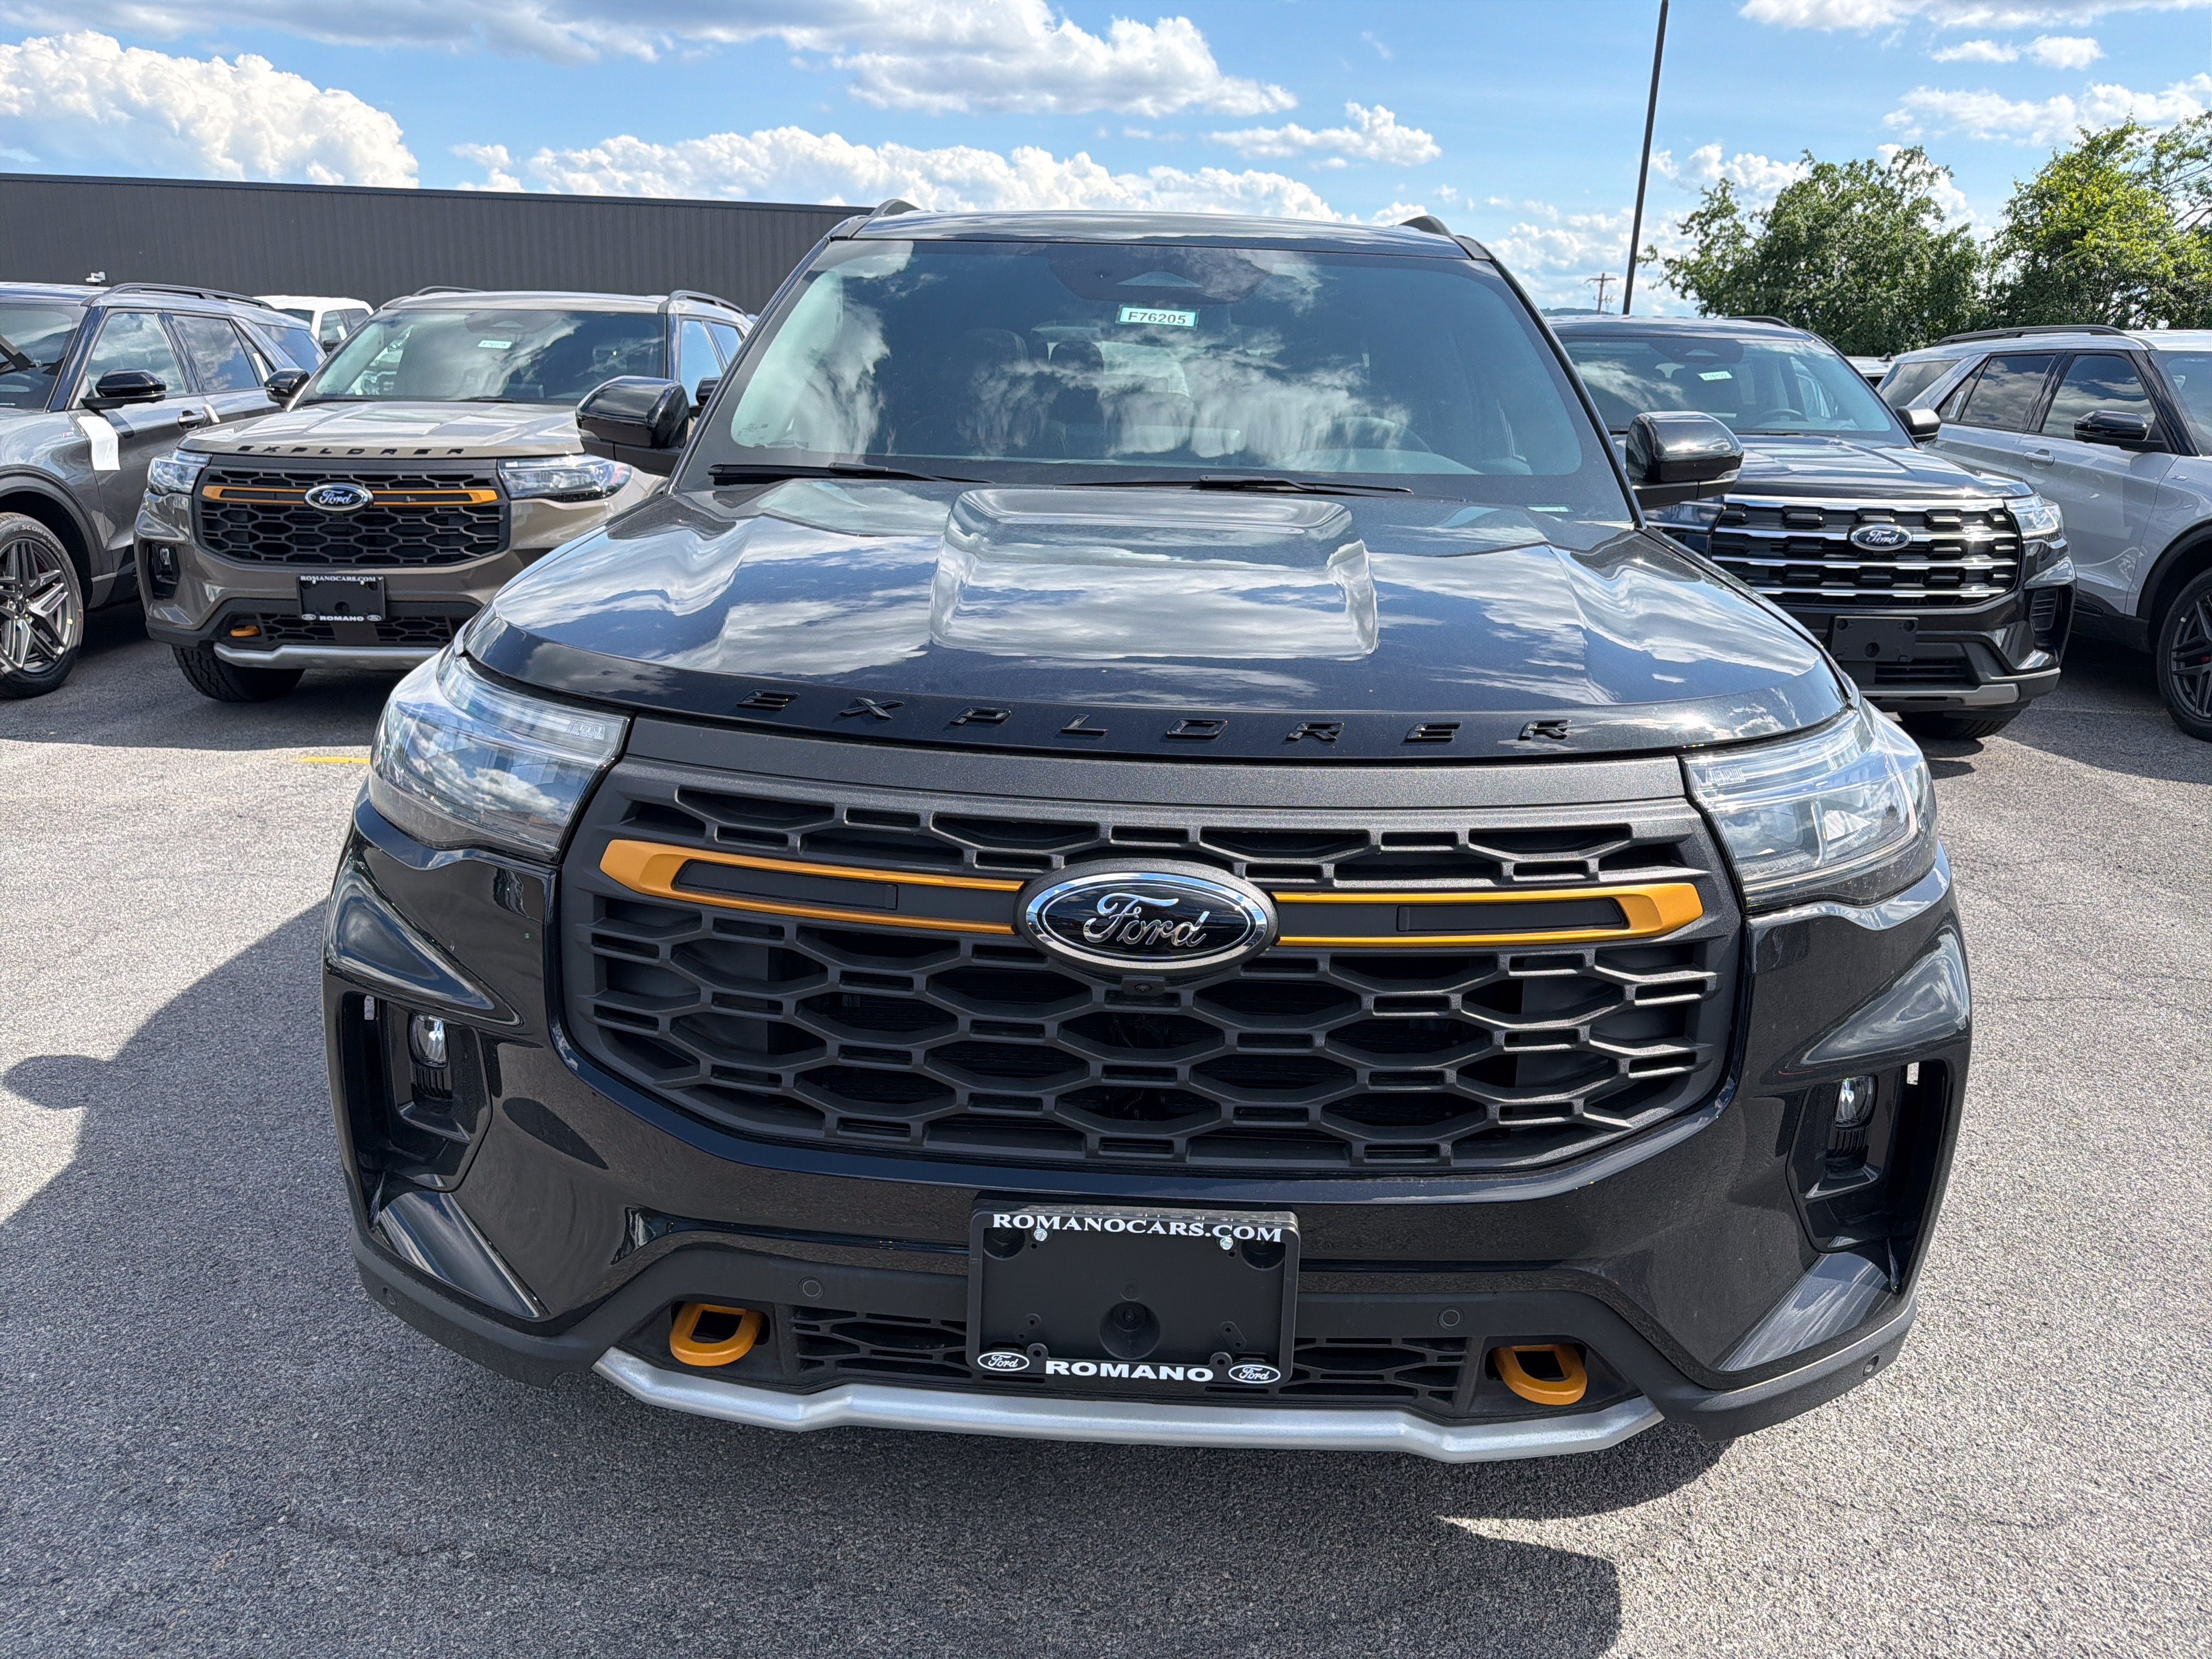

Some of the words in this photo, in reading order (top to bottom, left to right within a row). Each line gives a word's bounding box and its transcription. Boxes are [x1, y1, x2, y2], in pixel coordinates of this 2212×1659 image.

[1128, 311, 1186, 324] F76205
[237, 445, 464, 455] EXPLORER
[319, 490, 352, 504] Ford
[1865, 530, 1899, 545] Ford
[736, 689, 1572, 743] EXPLORER
[1082, 893, 1210, 947] Ford
[992, 1214, 1282, 1243] ROMANOCARS.COM
[988, 1355, 1019, 1367] Ford
[1046, 1361, 1214, 1382] ROMANO
[1239, 1367, 1270, 1380] Ford
